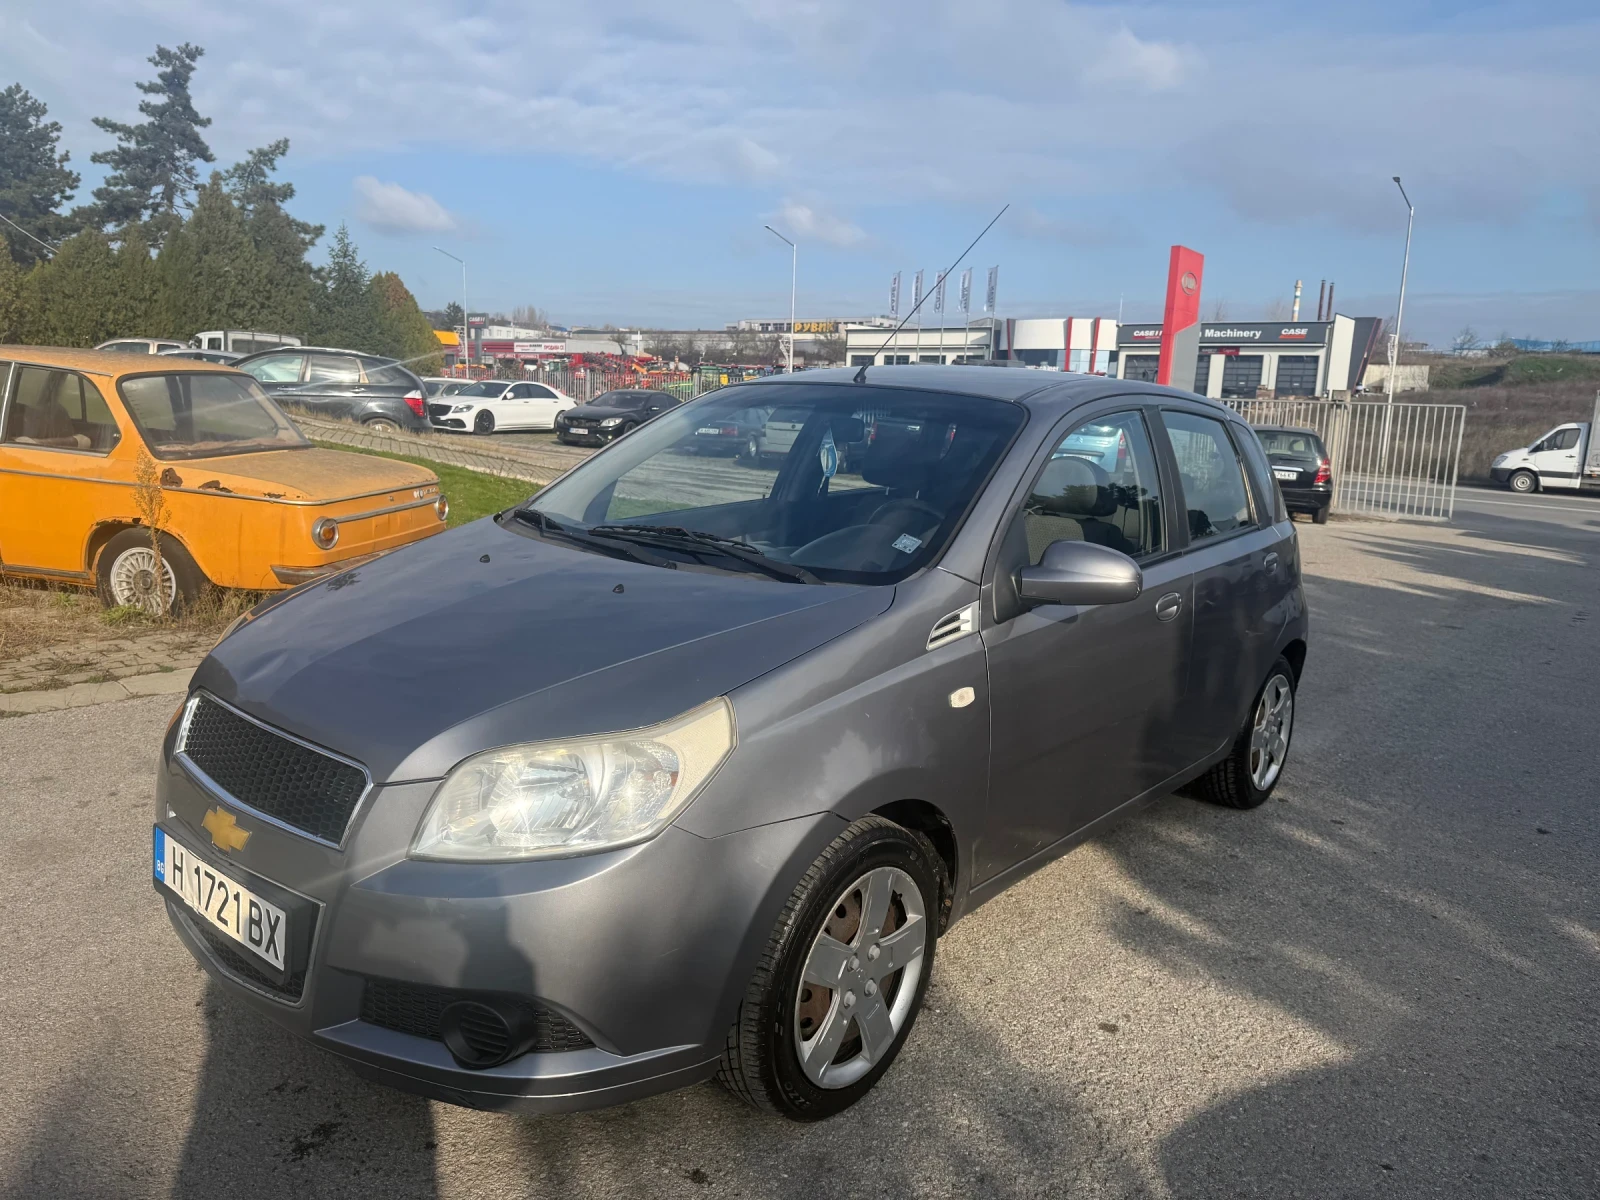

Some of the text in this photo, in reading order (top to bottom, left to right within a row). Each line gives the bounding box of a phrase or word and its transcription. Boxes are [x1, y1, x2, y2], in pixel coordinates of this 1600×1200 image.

[1204, 329, 1262, 340] Machinery
[157, 859, 164, 875] BG
[172, 845, 281, 961] H 1721 BX
